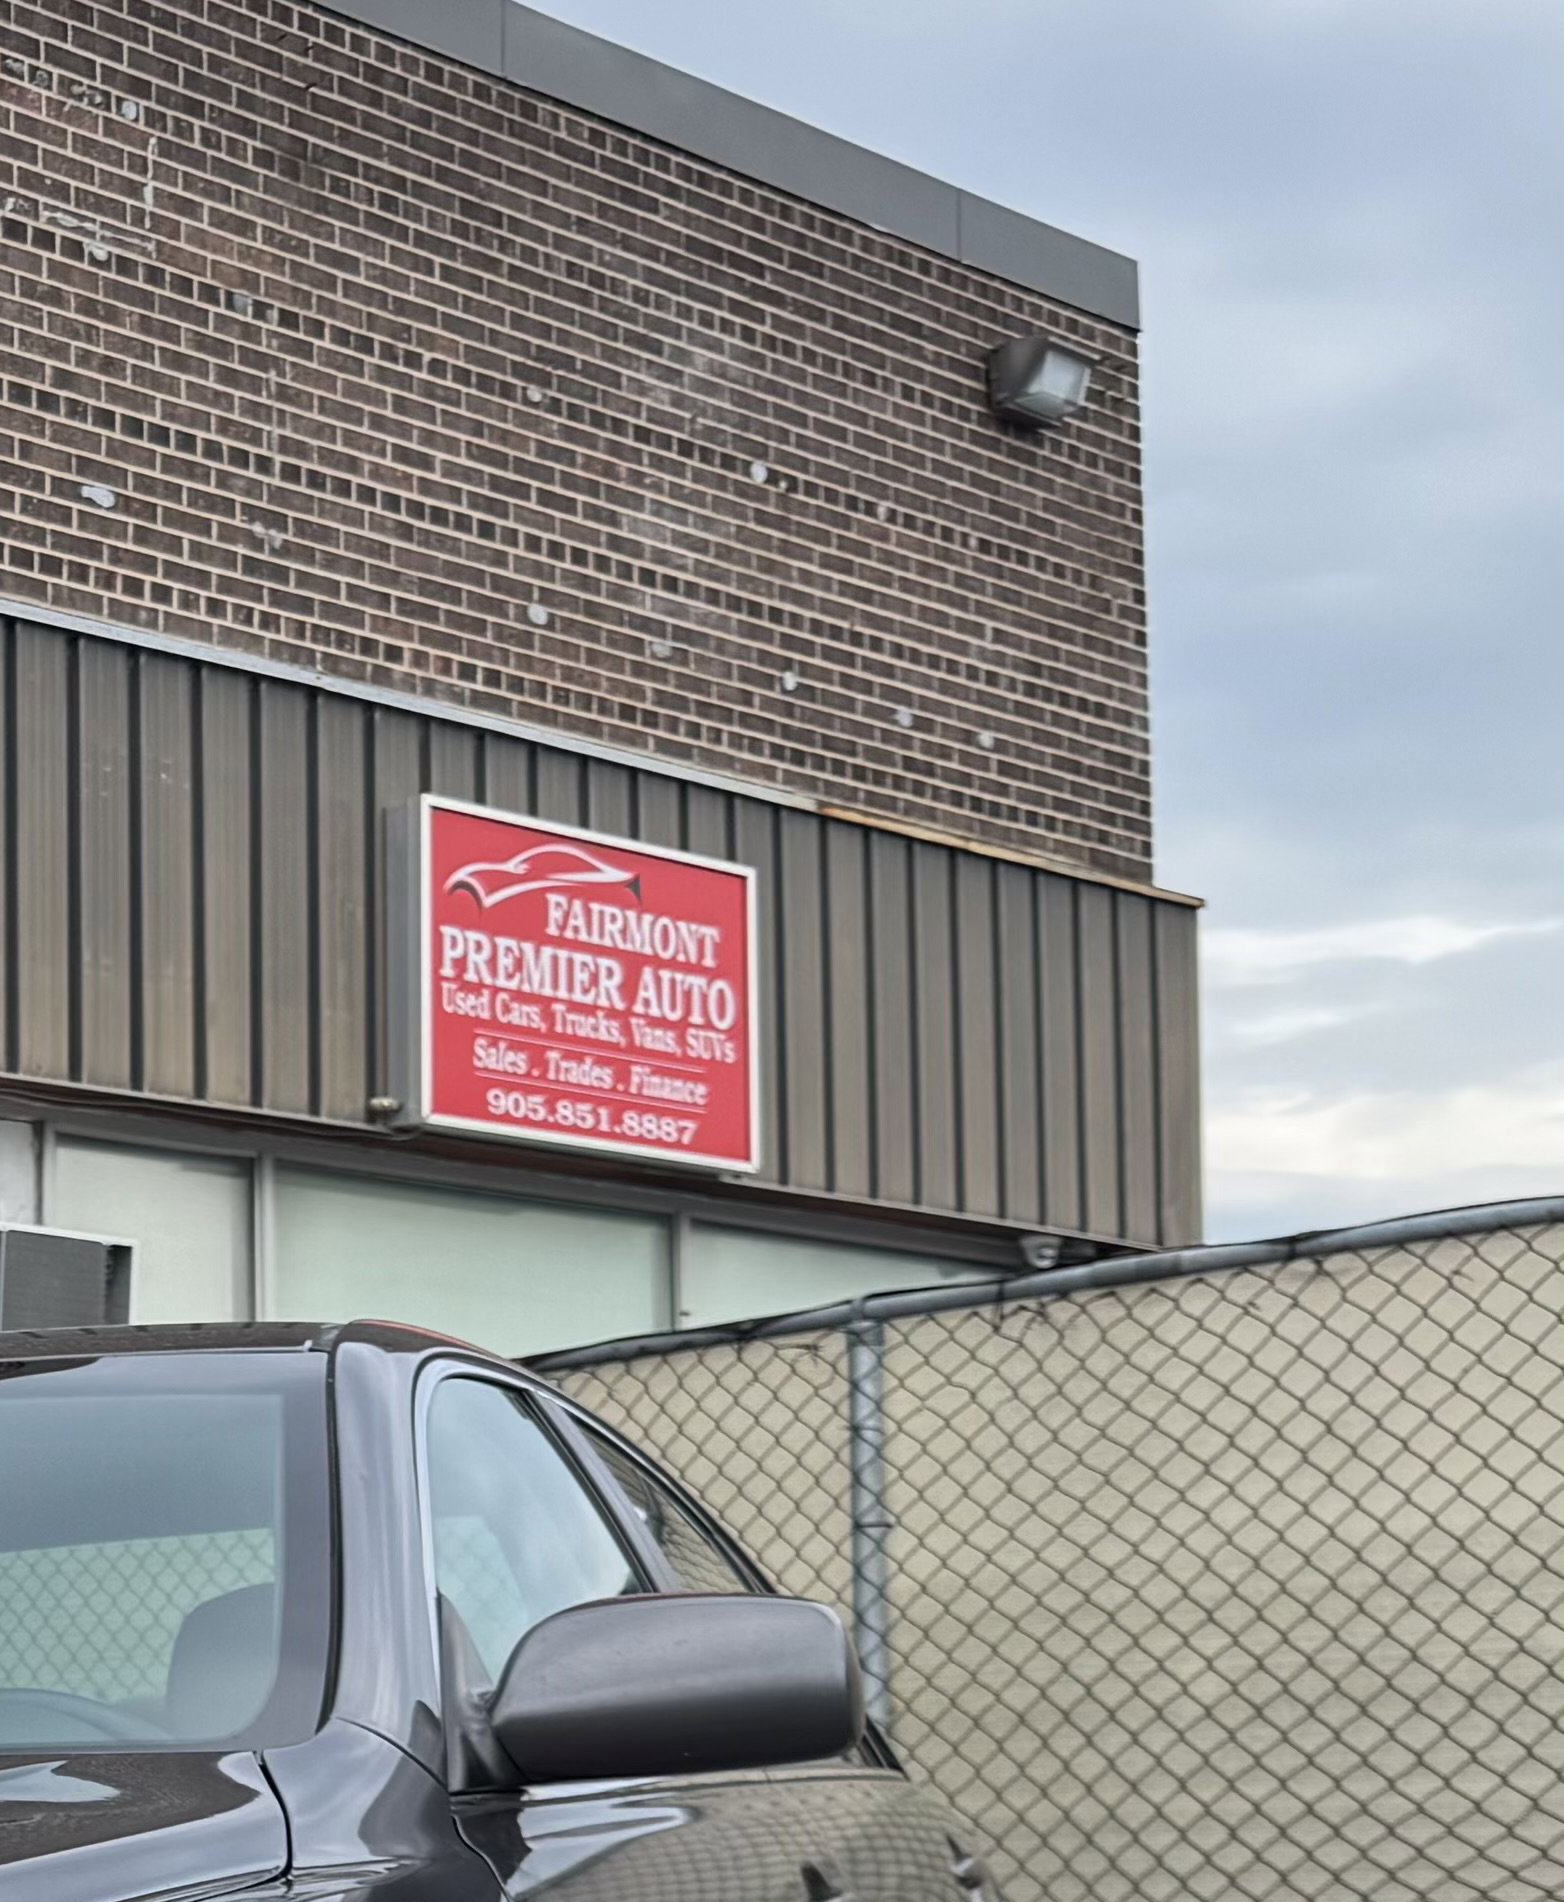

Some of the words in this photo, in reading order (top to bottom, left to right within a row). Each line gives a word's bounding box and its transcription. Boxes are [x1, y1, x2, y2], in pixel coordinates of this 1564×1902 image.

[544, 892, 720, 968] FAIRMONT
[438, 925, 626, 1011] PREMIER
[632, 965, 736, 1030] AUTO
[440, 981, 491, 1020] Used
[494, 991, 547, 1033] Cars,
[550, 1003, 626, 1048] Trucks,
[629, 1016, 682, 1057] Vans,
[472, 1036, 528, 1076] Sales
[544, 1050, 614, 1090] Trades
[628, 1064, 710, 1106] Finance
[485, 1087, 699, 1145] 905.851.8887
